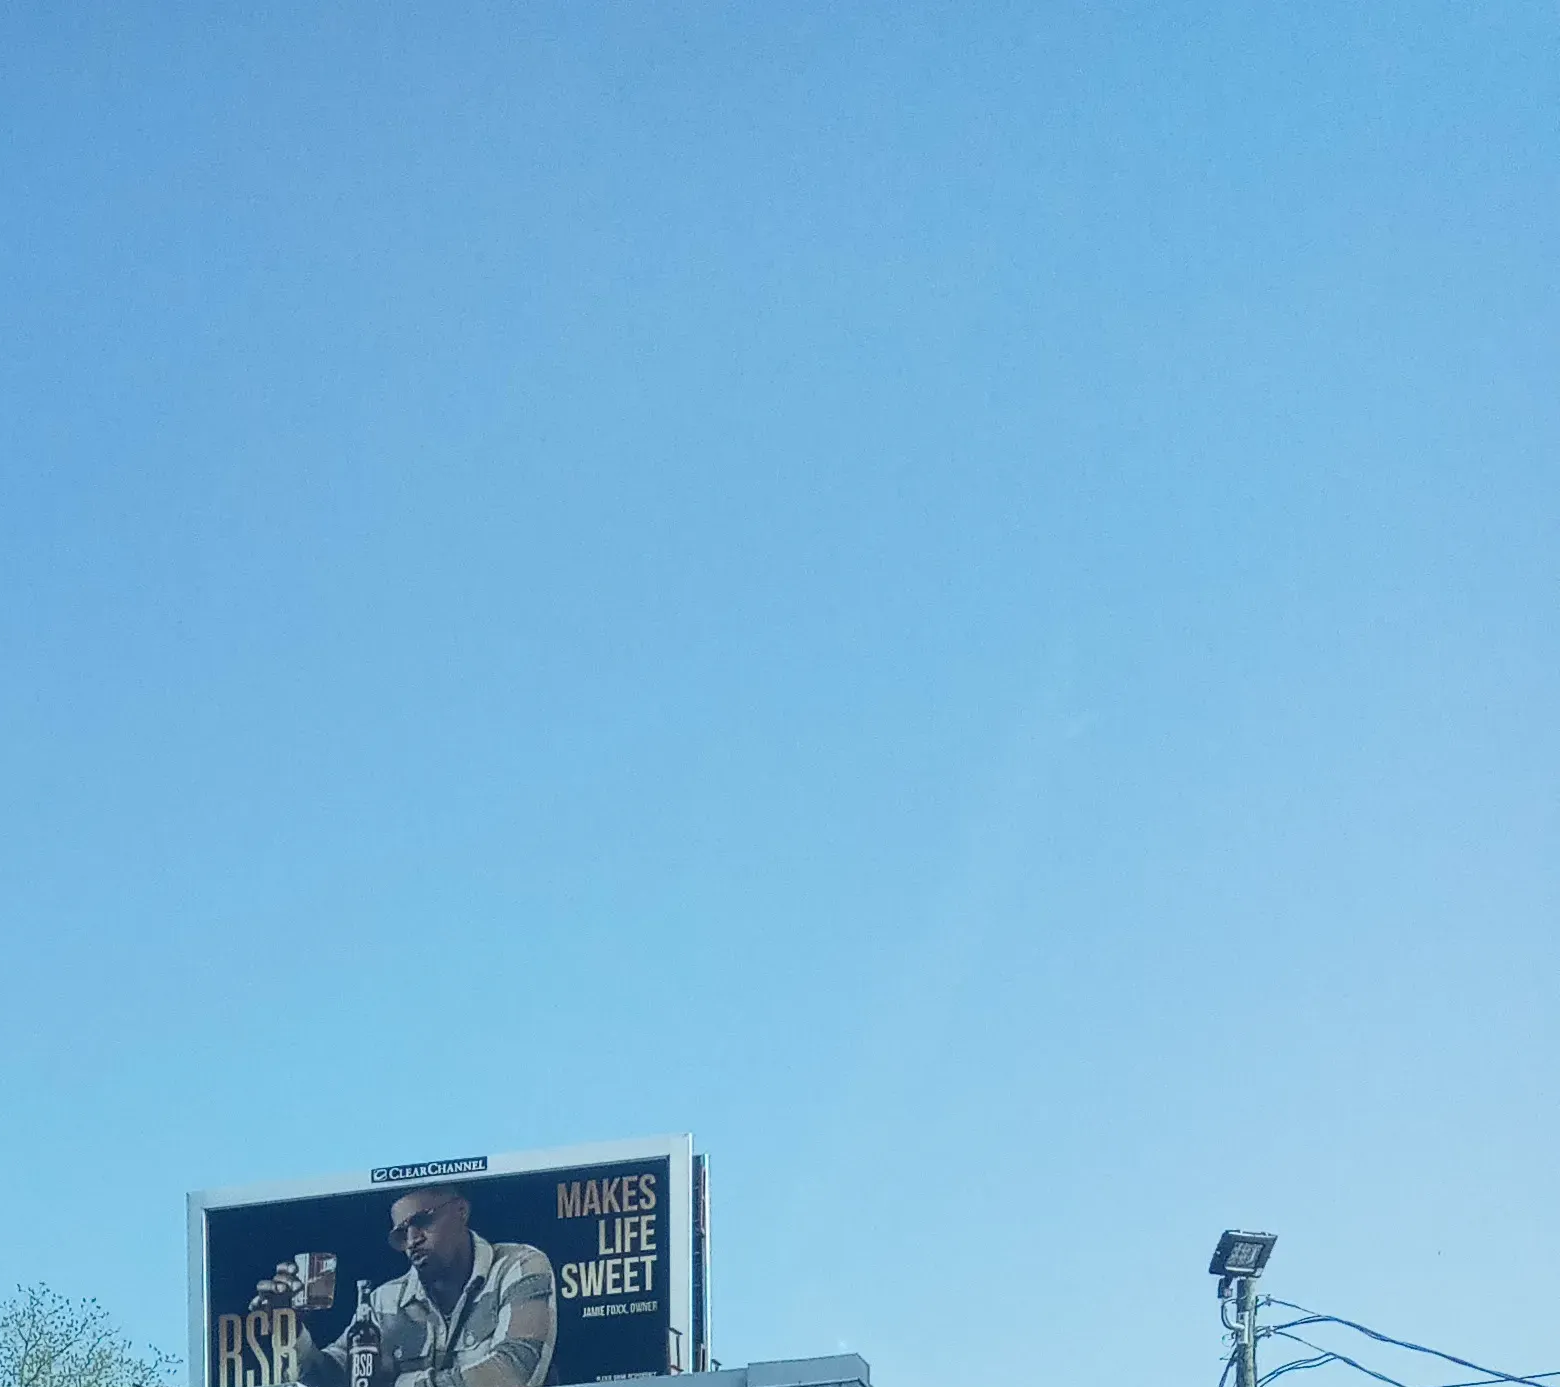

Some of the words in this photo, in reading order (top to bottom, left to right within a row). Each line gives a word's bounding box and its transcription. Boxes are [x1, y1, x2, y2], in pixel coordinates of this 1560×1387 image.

[557, 1173, 657, 1218] MAKES
[598, 1214, 657, 1255] LIFE
[561, 1255, 657, 1298] SWEET
[582, 1305, 605, 1318] JAMIE
[630, 1301, 658, 1314] OWNER
[353, 1353, 373, 1377] BSB
